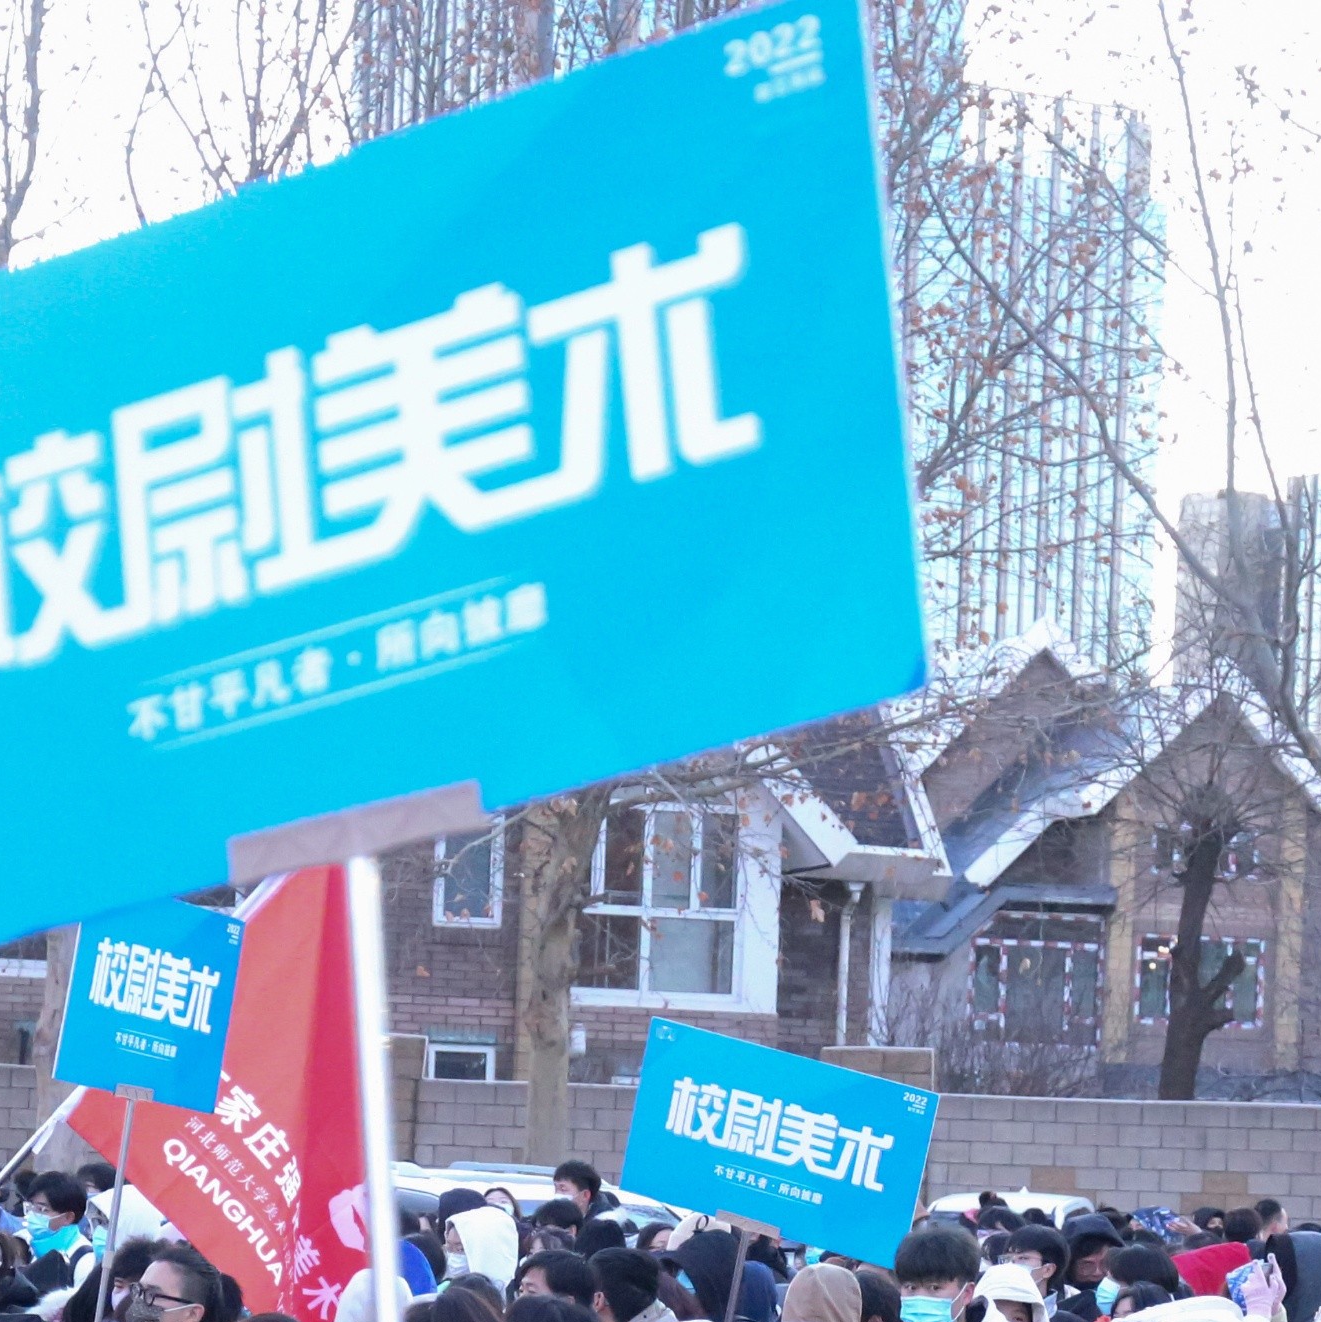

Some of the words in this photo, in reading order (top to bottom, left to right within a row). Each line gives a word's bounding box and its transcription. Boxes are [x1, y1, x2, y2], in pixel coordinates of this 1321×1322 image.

[724, 14, 821, 77] 2022
[89, 937, 221, 1034] 校尉美术
[665, 1076, 895, 1193] 校尉美术
[903, 1091, 927, 1107] 2022
[163, 1138, 284, 1287] QIANGHUA
